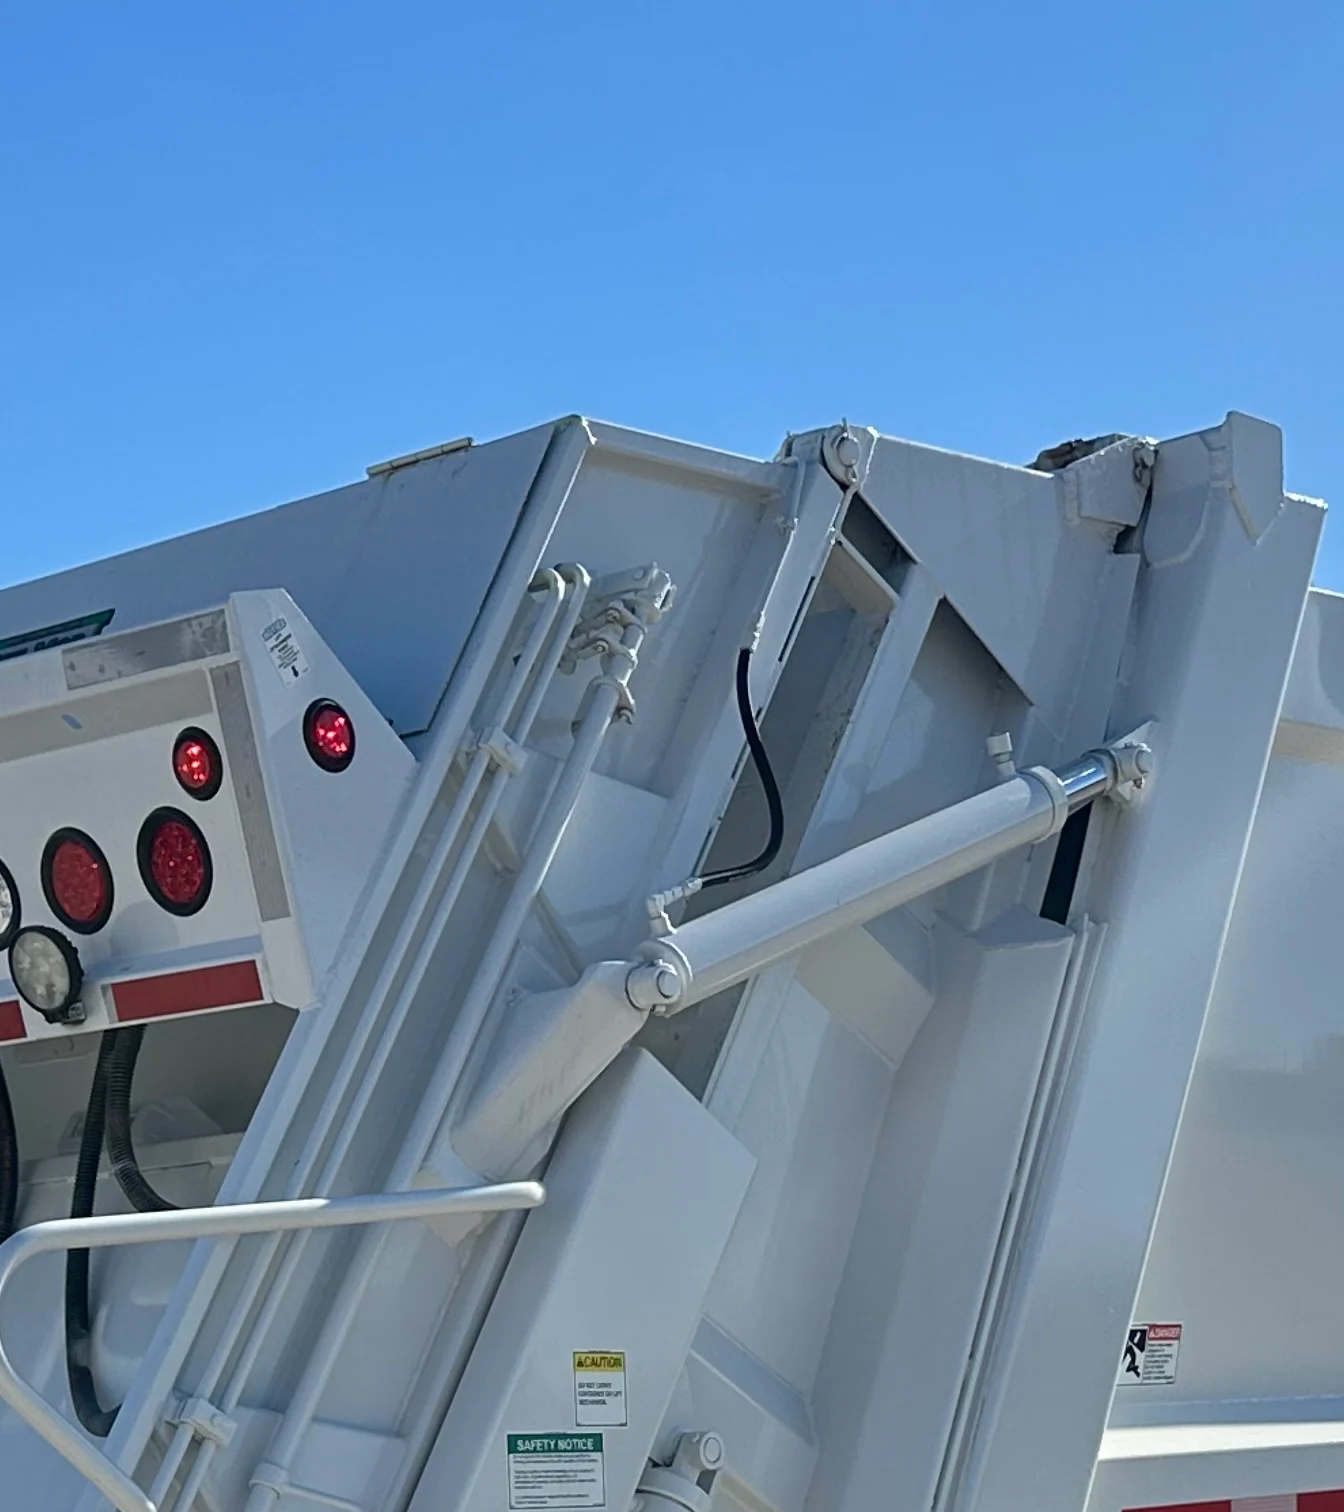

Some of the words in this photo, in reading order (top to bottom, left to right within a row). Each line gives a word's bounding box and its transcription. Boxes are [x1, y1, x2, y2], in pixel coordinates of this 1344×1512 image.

[584, 1355, 623, 1369] CAUTION
[516, 1439, 556, 1451] SAFETY
[557, 1438, 594, 1450] NOTICE
